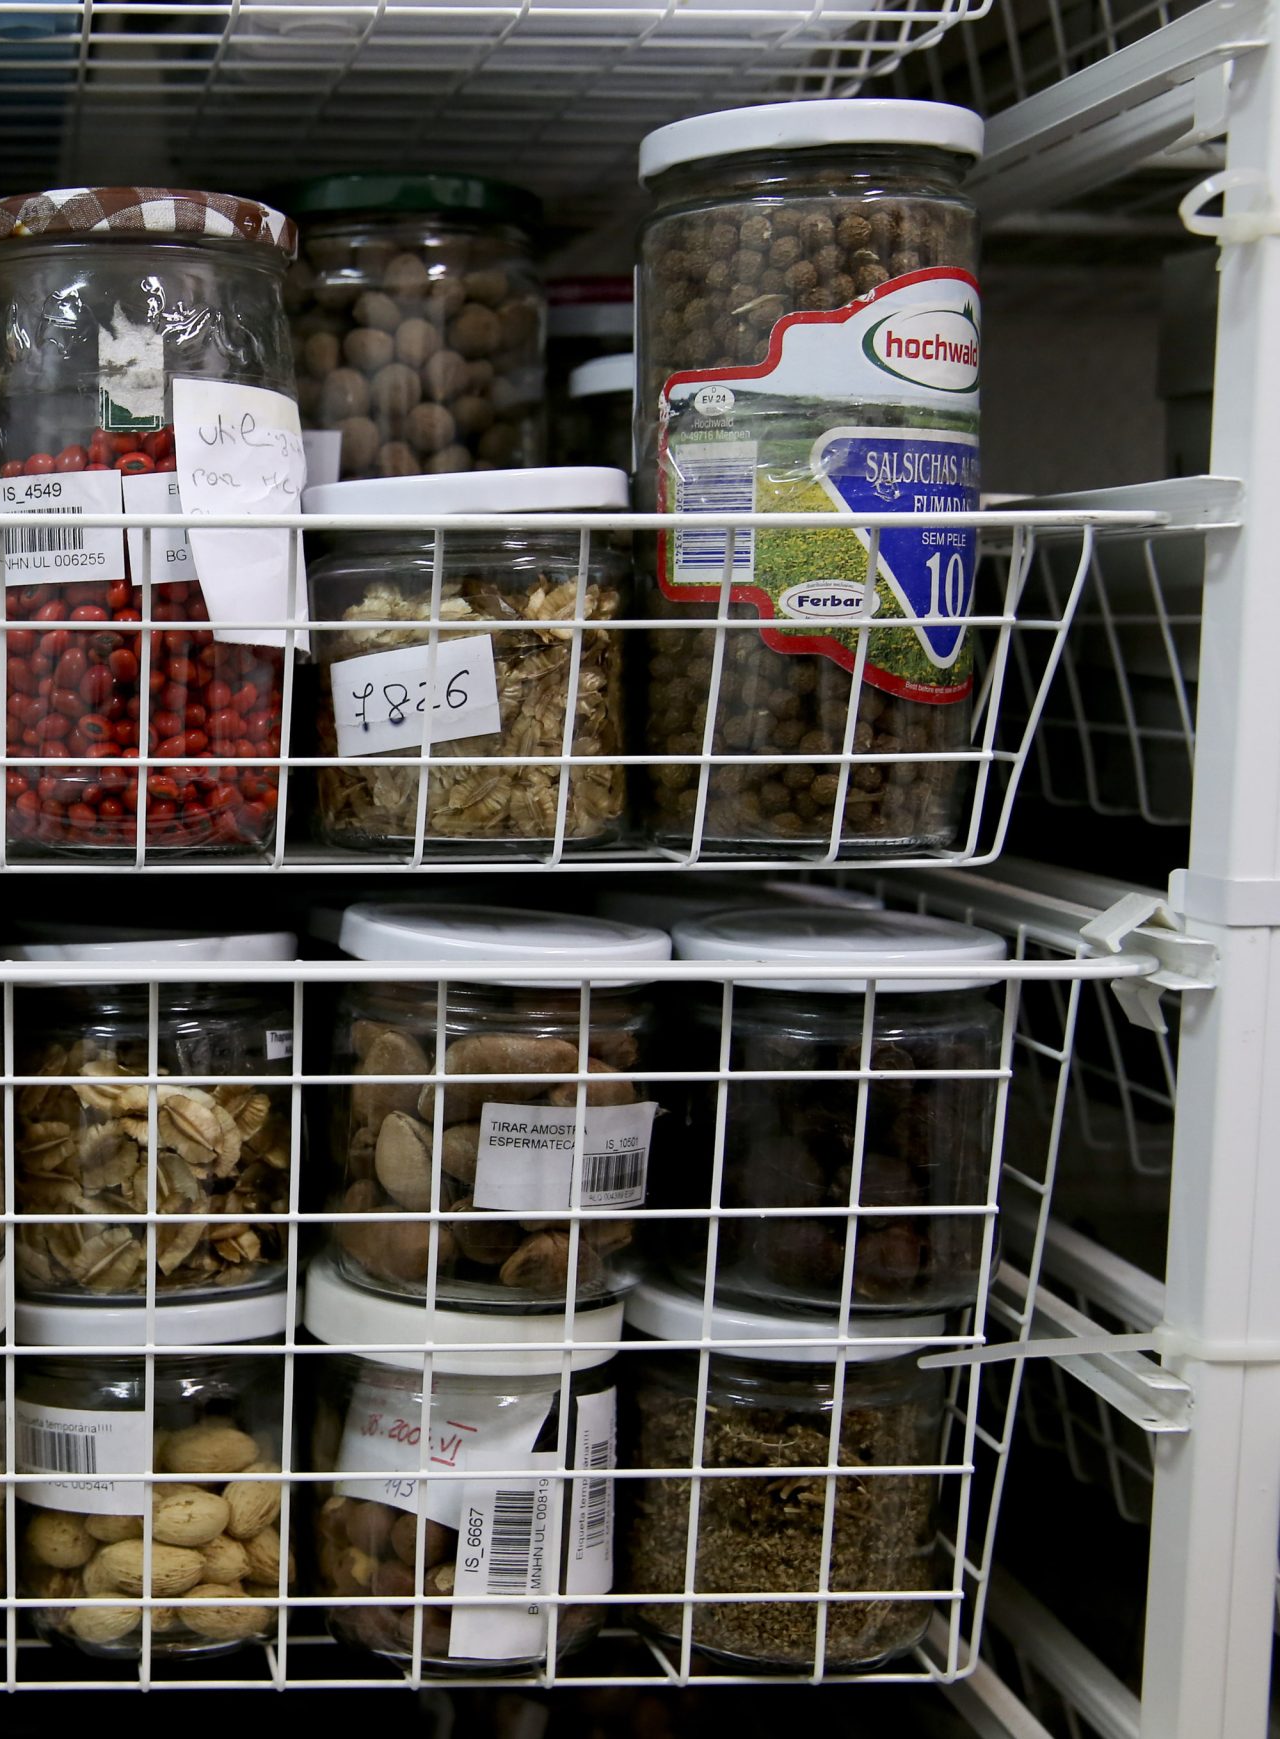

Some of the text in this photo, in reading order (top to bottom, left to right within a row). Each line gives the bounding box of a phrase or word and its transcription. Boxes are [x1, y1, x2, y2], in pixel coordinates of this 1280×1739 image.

[885, 330, 978, 368] hochwald
[702, 394, 726, 404] EV 24
[865, 451, 958, 485] SALSICHAS
[3, 482, 62, 504] IS_4549
[922, 531, 967, 547] SEM PELE
[33, 556, 50, 569] UL
[54, 552, 106, 568] 006255
[166, 549, 188, 563] BG
[925, 551, 964, 618] 10
[797, 594, 863, 608] Ferbar
[491, 1120, 527, 1134] TIRAR
[536, 1479, 549, 1521] 00819
[465, 1507, 484, 1573] IS_6667
[535, 1525, 546, 1543] UL
[575, 1512, 586, 1560] Etiqueta
[530, 1547, 544, 1589] MNHN
